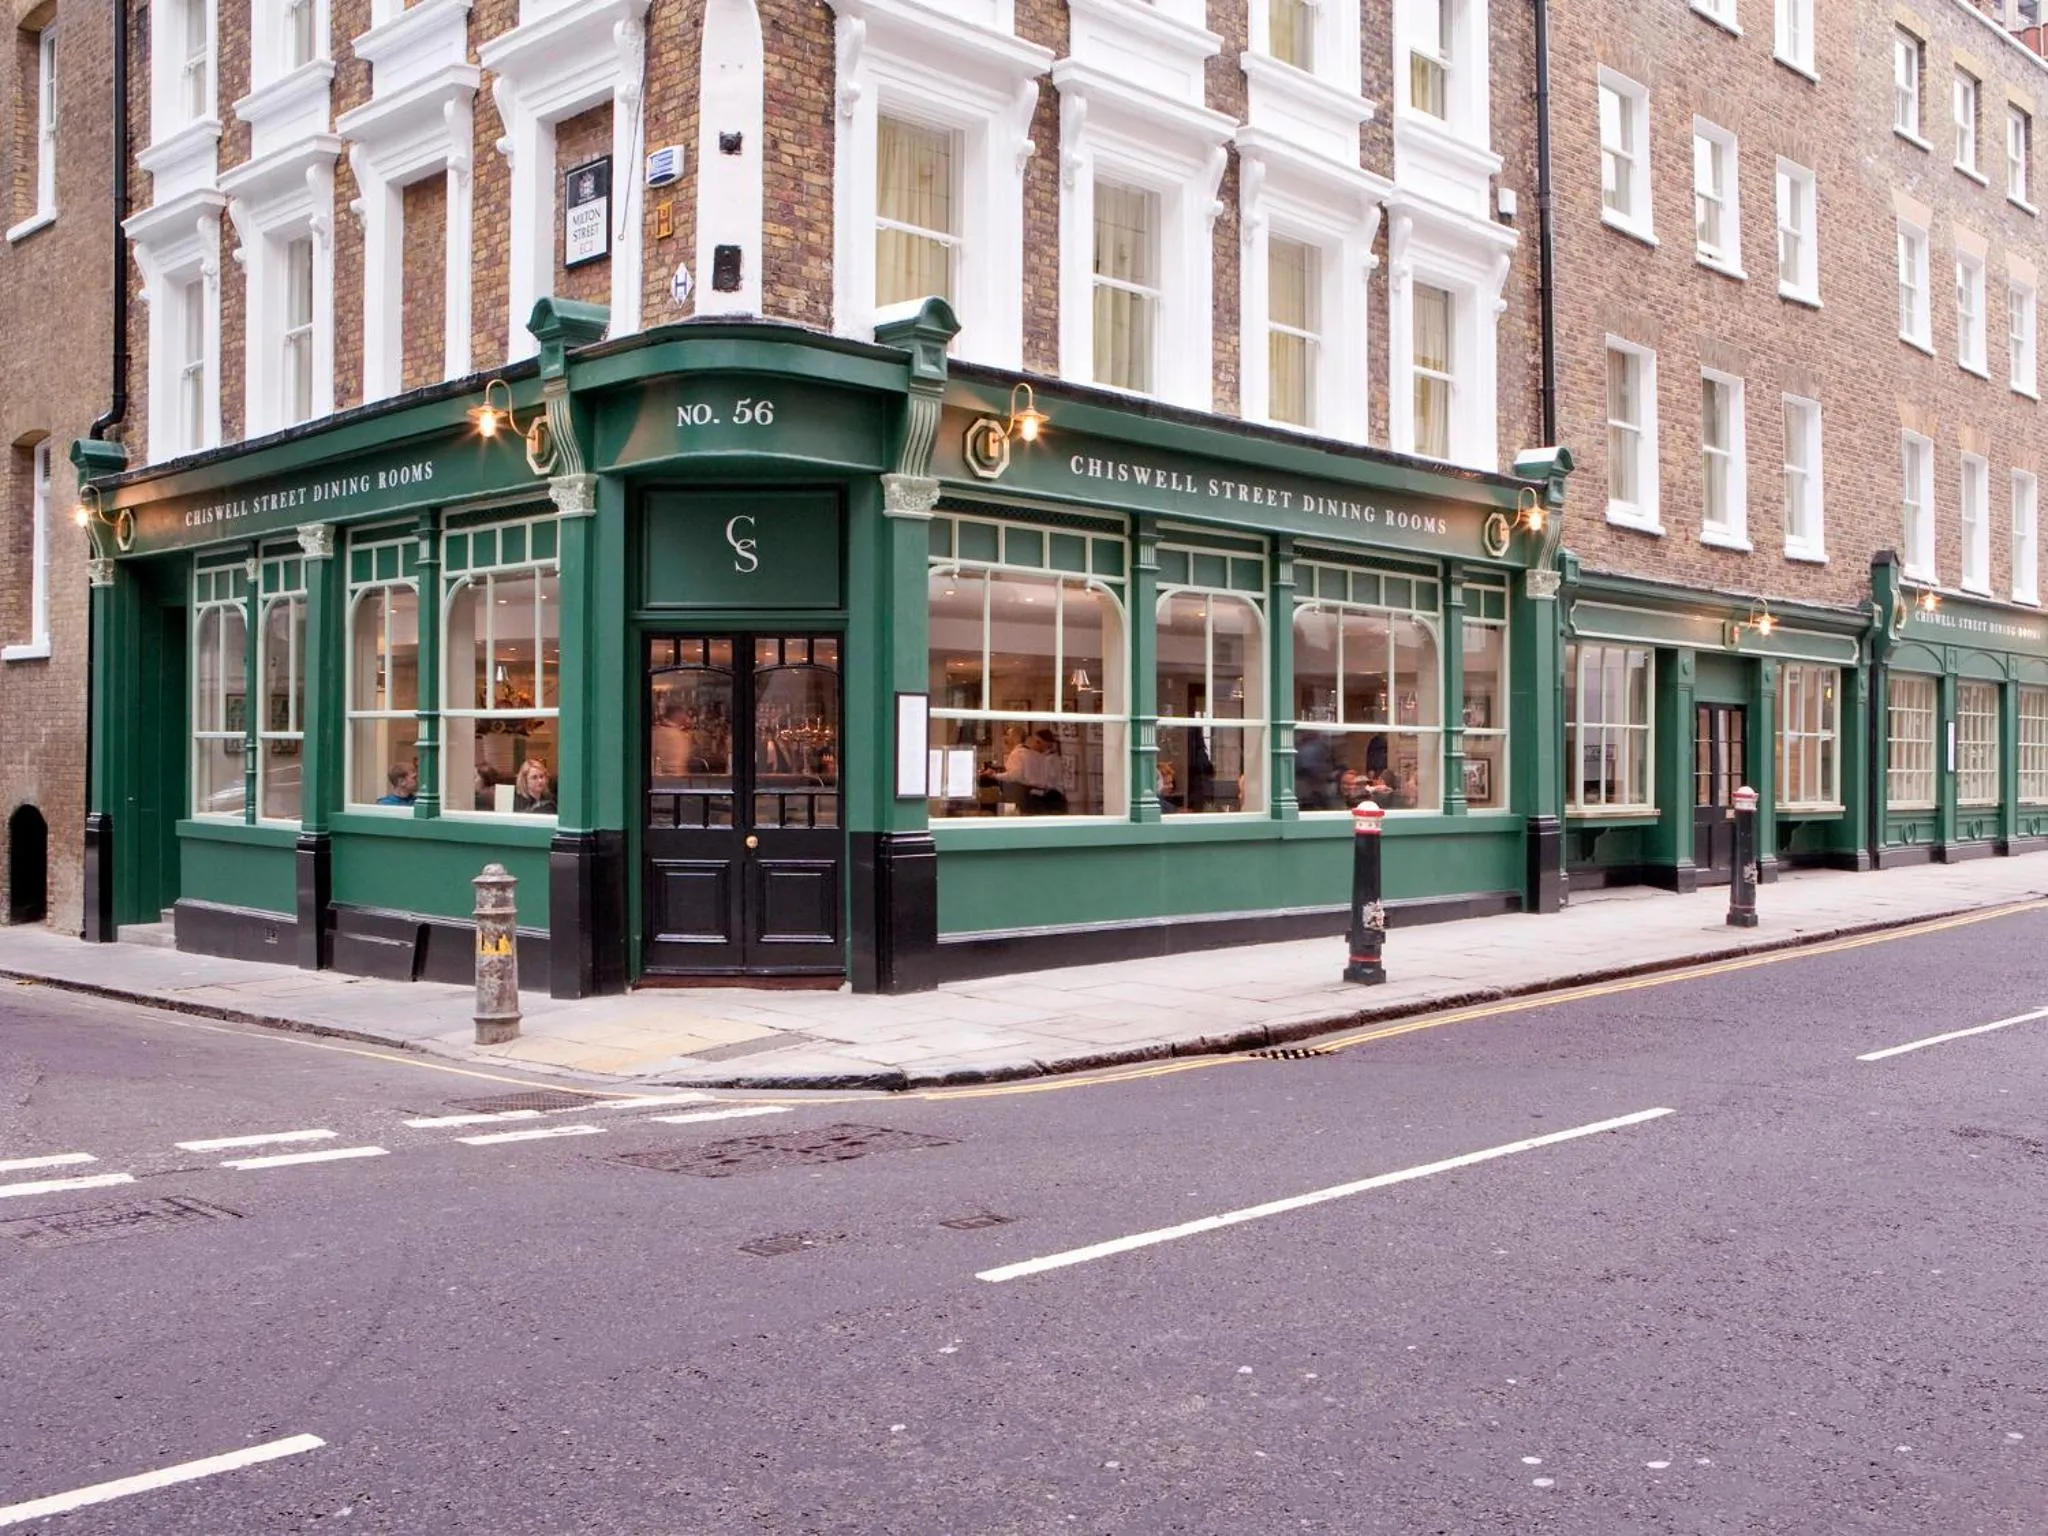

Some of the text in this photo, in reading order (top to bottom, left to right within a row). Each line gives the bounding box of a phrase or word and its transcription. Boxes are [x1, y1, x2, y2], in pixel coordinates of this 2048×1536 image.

[572, 207, 602, 226] MILTON
[572, 222, 600, 243] STREET
[674, 271, 688, 297] H
[677, 398, 775, 427] NO. 56
[185, 461, 433, 527] CHISWELL STREET DINING ROOMS
[1070, 455, 1447, 535] CHISWELL STREET DINING ROOMS
[1914, 610, 1956, 628] CHISWELL
[1958, 617, 1988, 632] STREET
